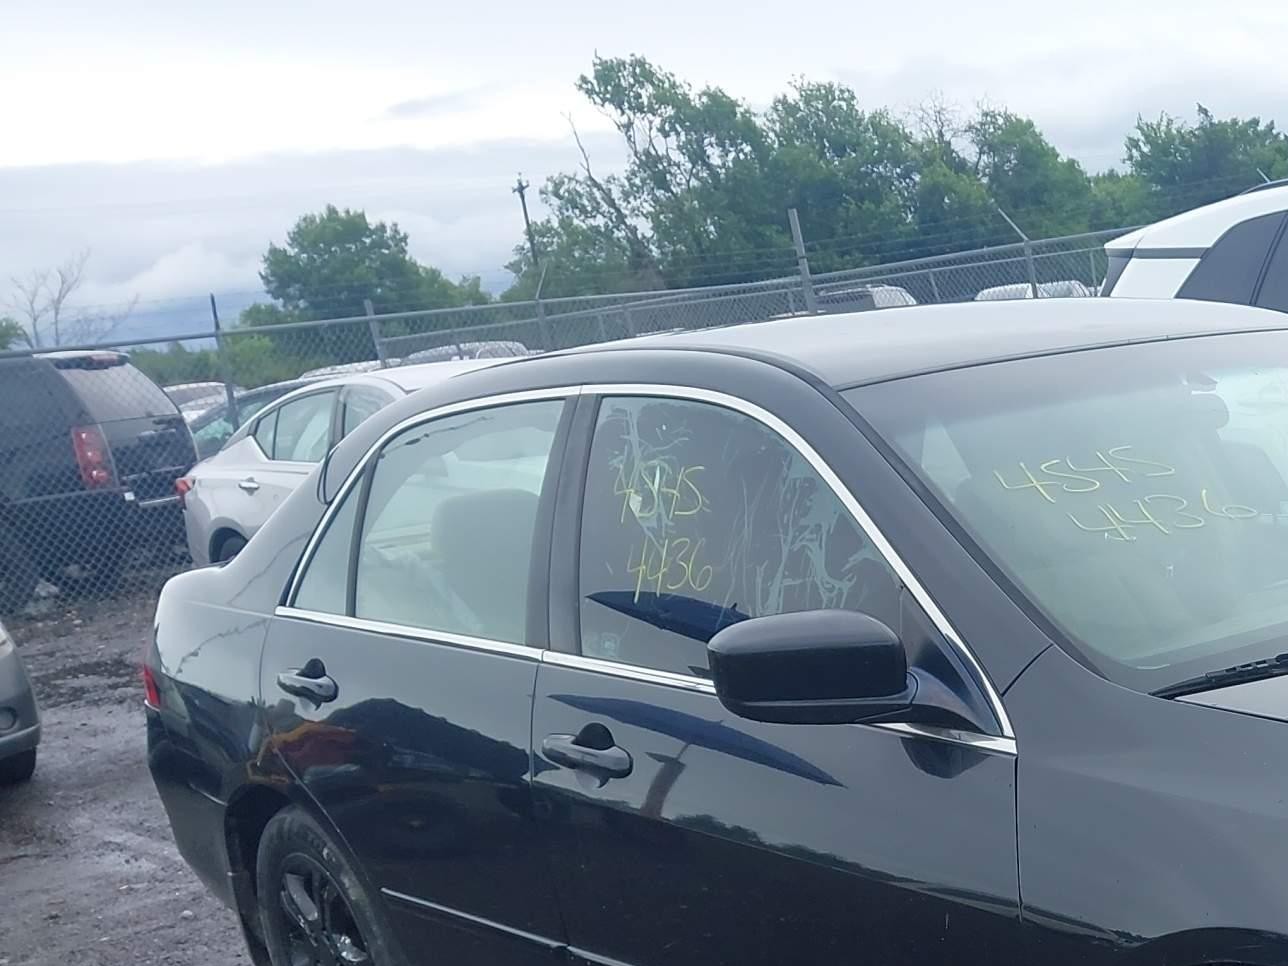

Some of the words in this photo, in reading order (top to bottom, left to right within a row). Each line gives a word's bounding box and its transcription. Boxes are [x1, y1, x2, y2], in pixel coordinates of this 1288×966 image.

[614, 464, 706, 524] 4545
[993, 445, 1176, 503] 4545
[1066, 489, 1258, 541] 4436
[626, 534, 713, 604] 4436
